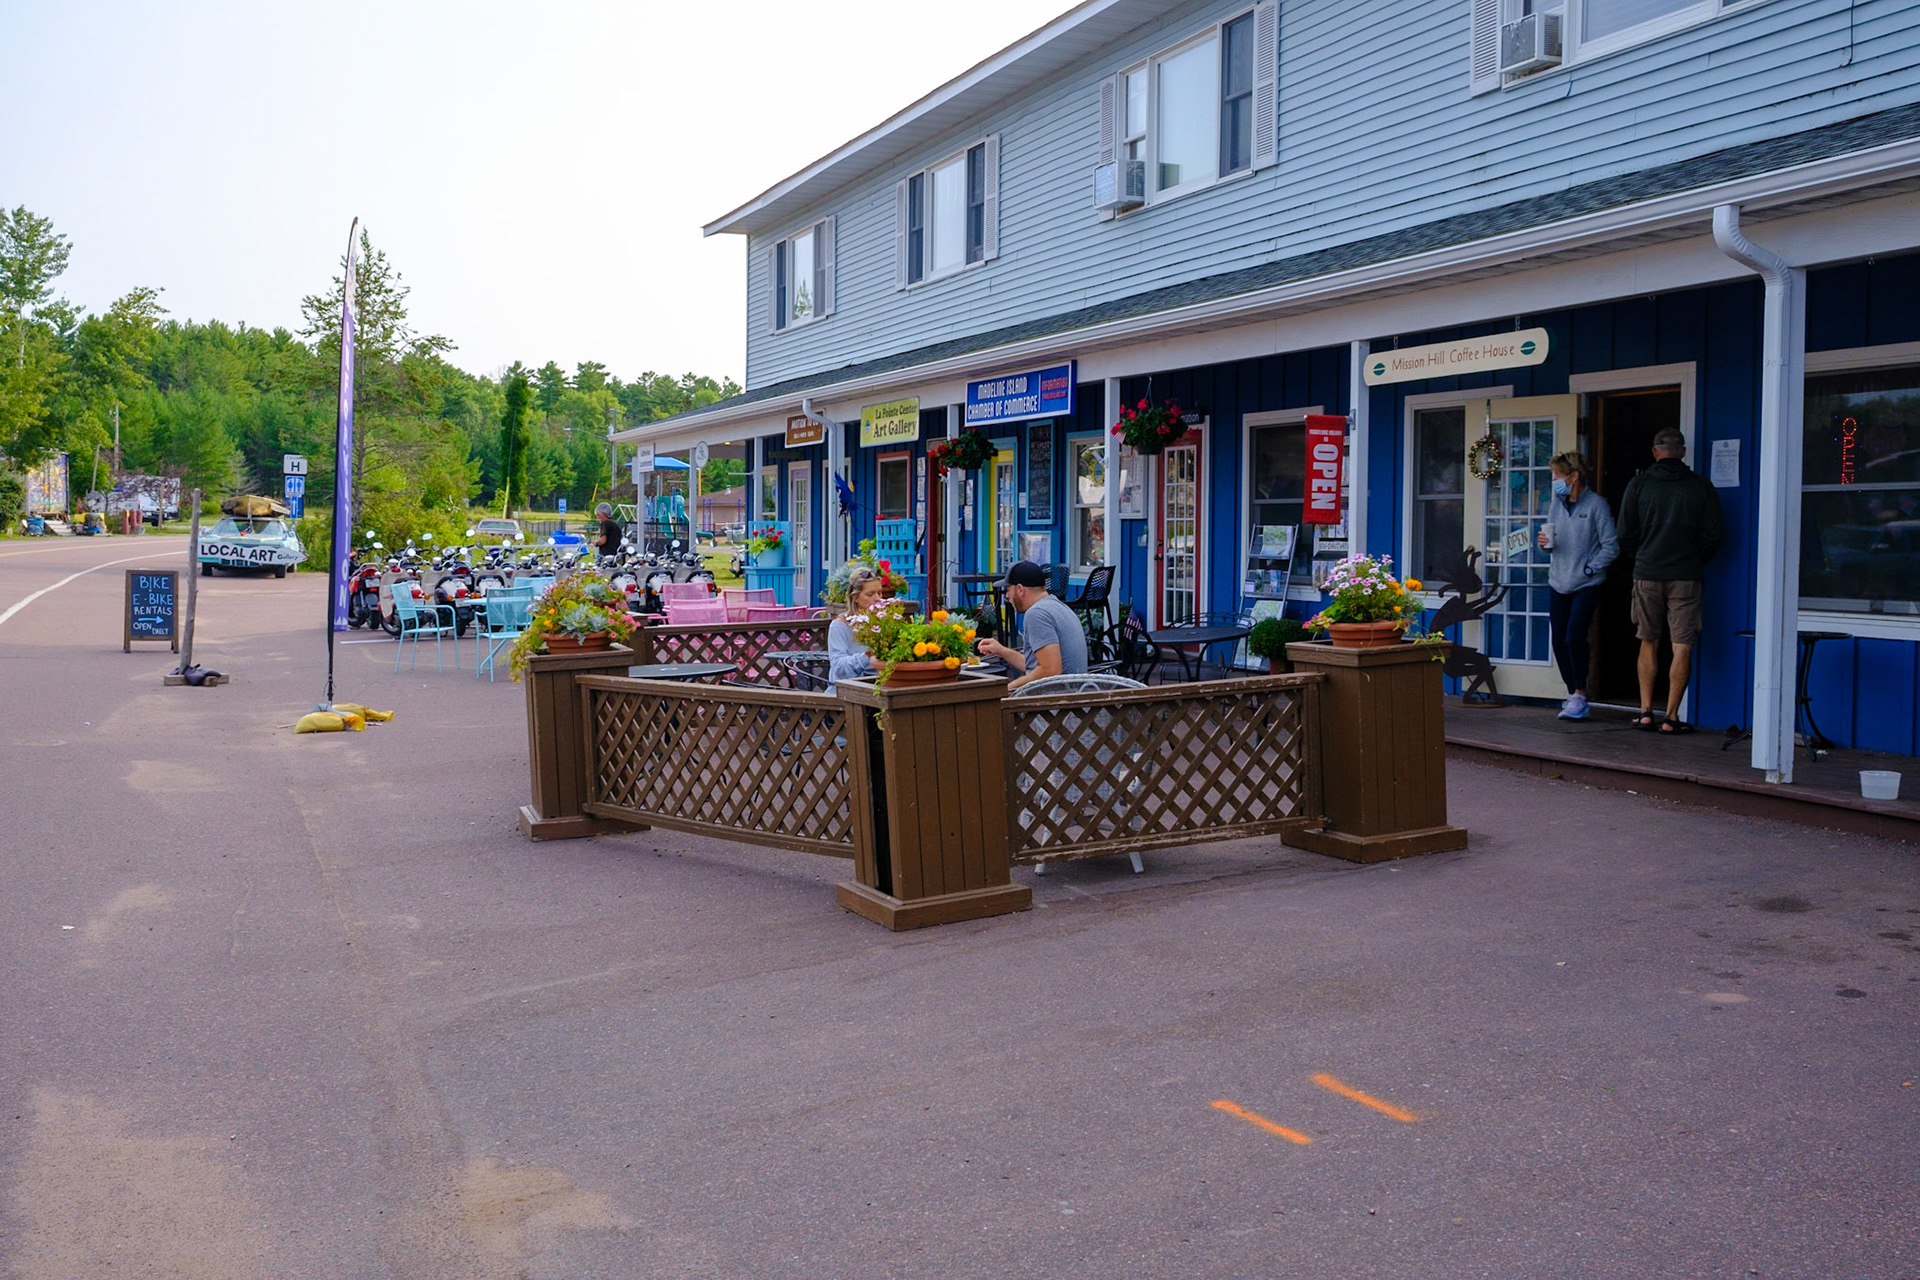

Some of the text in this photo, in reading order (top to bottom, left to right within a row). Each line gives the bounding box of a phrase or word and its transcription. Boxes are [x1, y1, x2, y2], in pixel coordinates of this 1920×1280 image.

[1391, 344, 1515, 371] Mission Hill Coffee House
[977, 381, 1006, 400] MADELINE
[1006, 376, 1028, 396] ISLAND
[875, 404, 917, 420] La Pointe Center
[967, 401, 995, 420] CHAMBER
[995, 401, 1003, 417] OF
[1003, 394, 1038, 415] COMMERCE
[873, 419, 917, 438] Art Gallery
[1842, 417, 1857, 486] OPEN
[291, 461, 300, 472] H
[1311, 443, 1339, 510] OPEN
[1507, 531, 1528, 550] OPEN
[201, 544, 246, 559] LOCAL
[248, 549, 277, 562] ART
[139, 575, 170, 590] BIKE
[133, 606, 173, 616] RENTALS
[132, 622, 170, 636] OPEN DAILY
